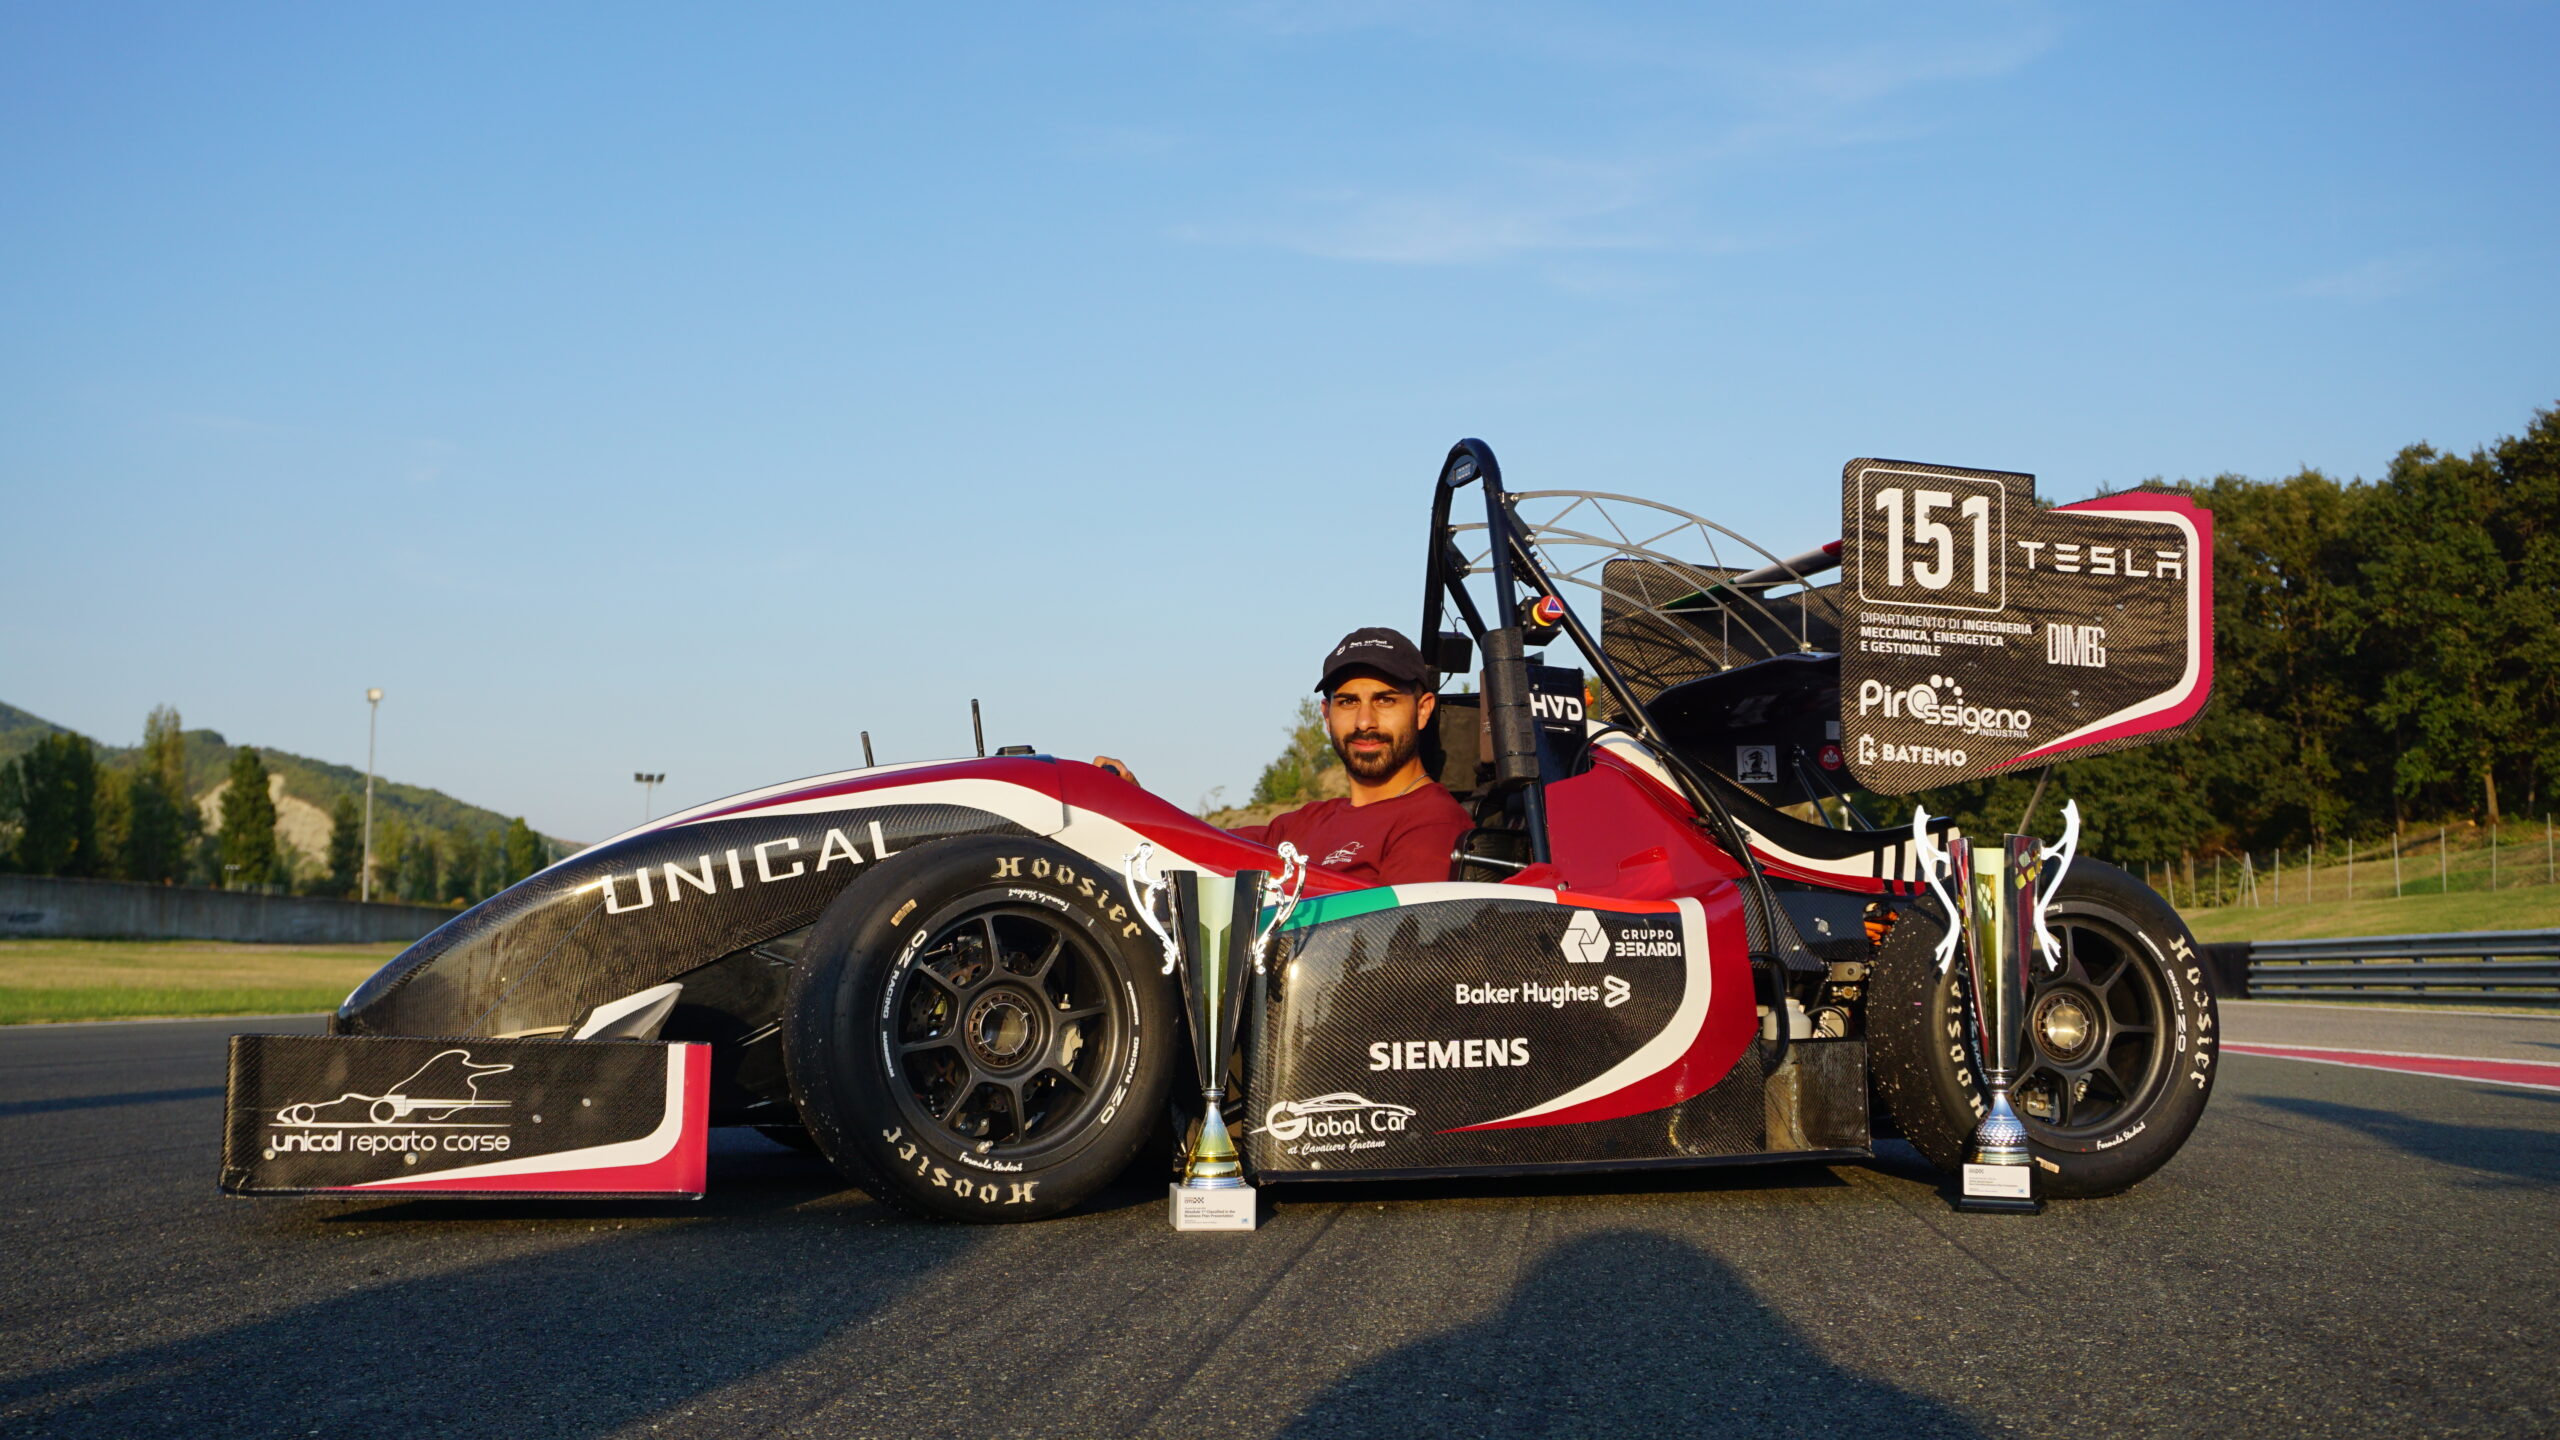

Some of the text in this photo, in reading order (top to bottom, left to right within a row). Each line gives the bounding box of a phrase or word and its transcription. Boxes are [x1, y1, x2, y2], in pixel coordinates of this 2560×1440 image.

[1876, 488, 1990, 594] 151
[2017, 541, 2182, 580] TESLA
[1860, 612, 2033, 635] DIPARTIMENTO DI INGEGNERIA
[1860, 626, 2004, 647] MECCANICA, ENERGETICA
[1860, 641, 1942, 656] E GESTIONALE
[2047, 623, 2106, 668] DIMEG
[1529, 693, 1583, 721] HVD
[1979, 728, 2030, 739] INDUSTRIA
[1882, 744, 1967, 767] BATEMO
[600, 820, 902, 915] UNICAL
[990, 856, 1142, 939] Hoosier
[1615, 941, 1682, 957] BERARDI
[1621, 929, 1674, 941] GRUPPO
[882, 969, 900, 1020] RACING
[1455, 981, 1599, 1009] Baker Hughes
[2167, 968, 2185, 1011] RACING
[2167, 934, 2215, 1090] Hoosier
[1124, 1035, 1140, 1084] RACING
[1369, 1037, 1530, 1072] SIEMENS
[1265, 1100, 1409, 1141] Global Car
[271, 1130, 511, 1157] unical reparto corse
[958, 1151, 992, 1170] Formula
[882, 1126, 1040, 1205] Hoosier
